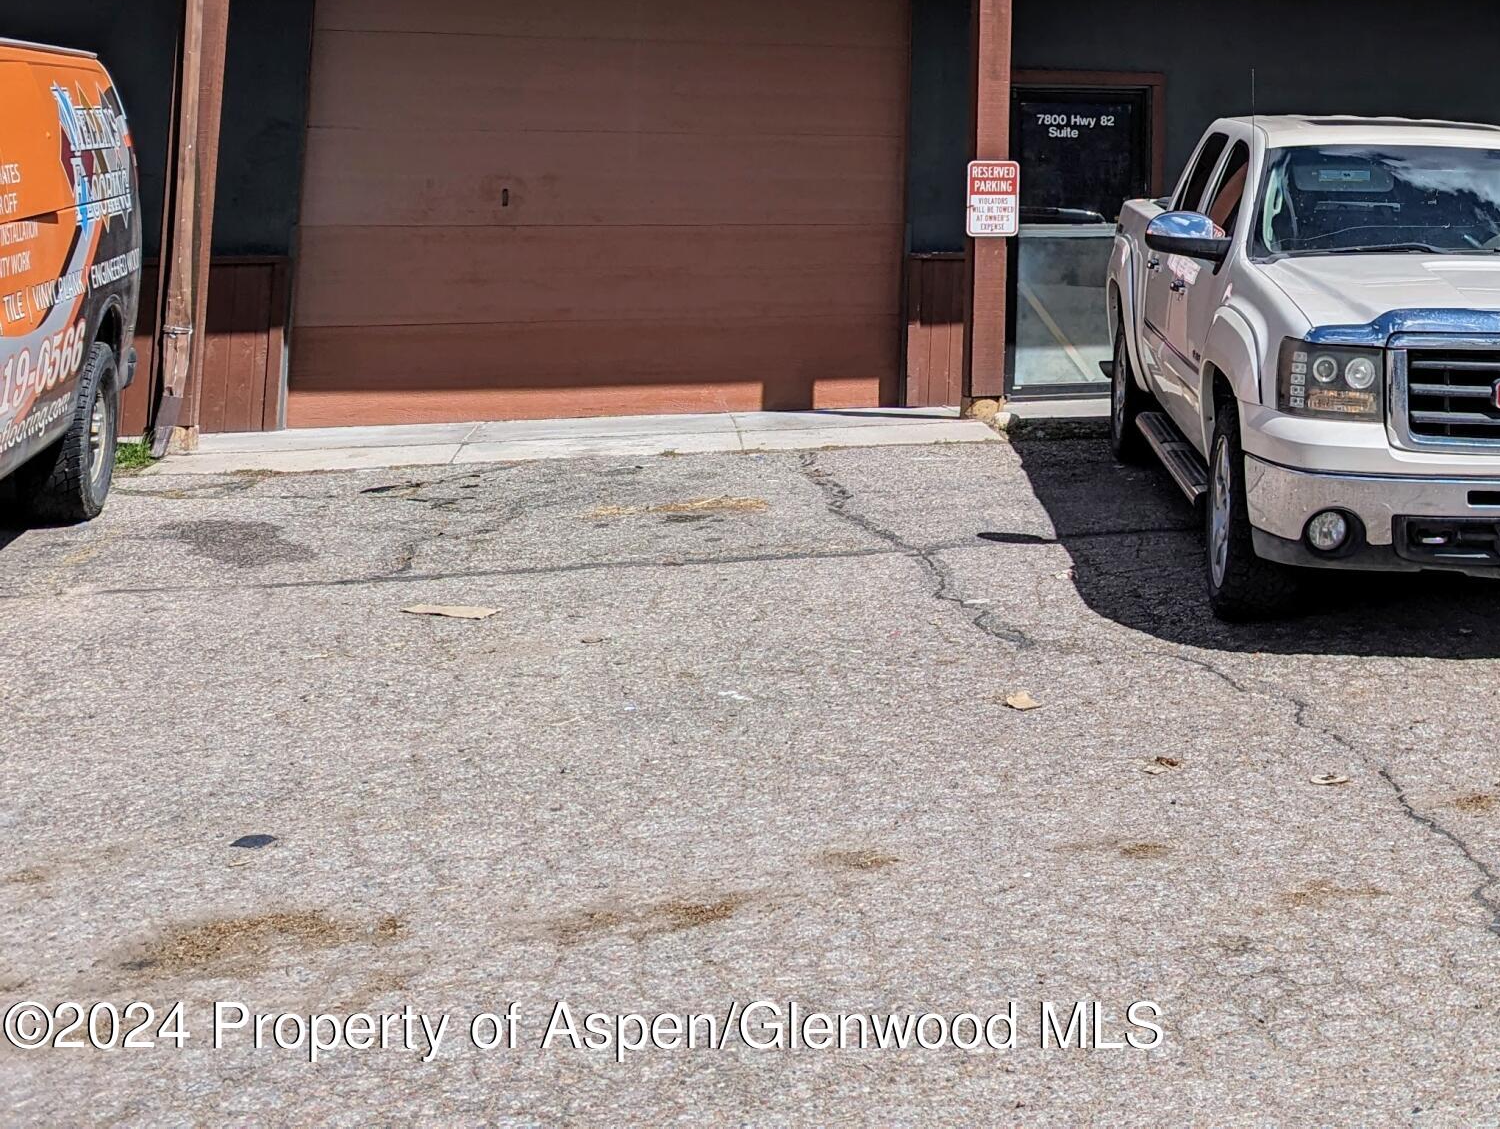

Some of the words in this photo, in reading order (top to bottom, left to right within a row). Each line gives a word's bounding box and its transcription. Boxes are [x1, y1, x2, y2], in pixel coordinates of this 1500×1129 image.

[1036, 114, 1067, 125] 7800
[1070, 114, 1097, 129] Hwy
[1100, 115, 1115, 126] 82
[1048, 126, 1079, 138] Suite
[972, 166, 1016, 179] RESERVED
[974, 180, 1013, 193] PARKING
[978, 197, 1009, 205] VIOLATORS
[11, 250, 31, 276] WORK
[3, 291, 25, 323] TILE
[32, 279, 59, 311] VINYL
[58, 269, 85, 304] PLANK
[91, 254, 128, 289] ENGINEERED
